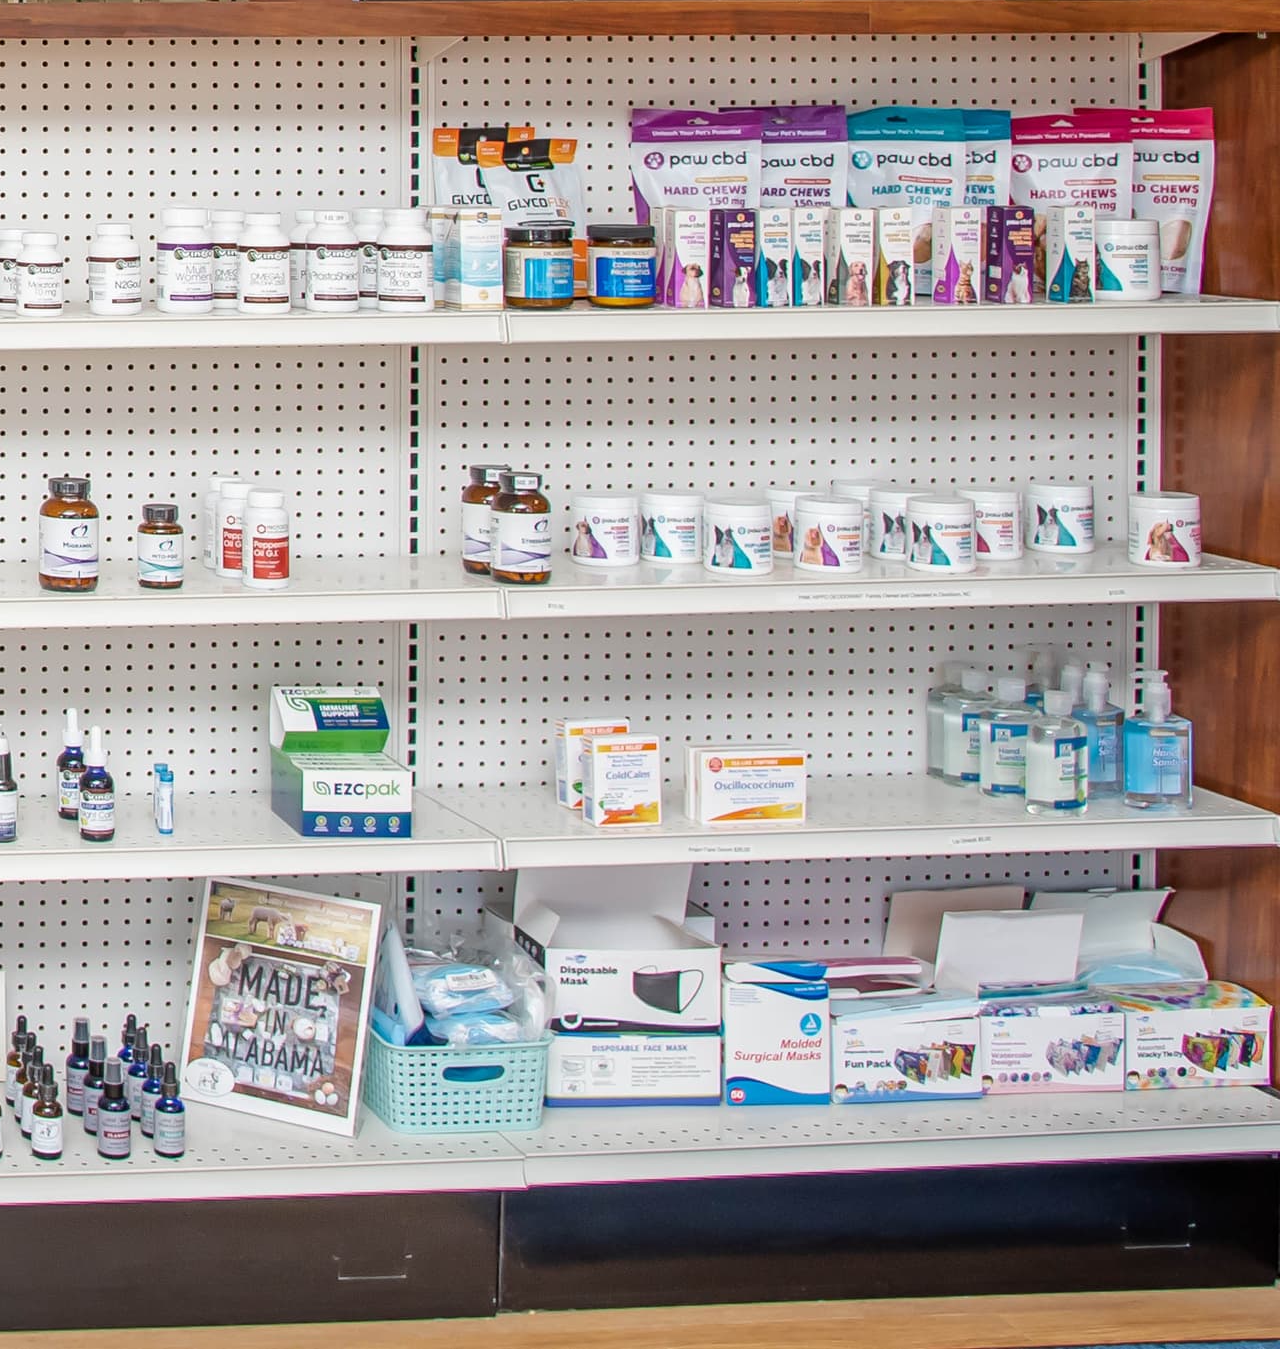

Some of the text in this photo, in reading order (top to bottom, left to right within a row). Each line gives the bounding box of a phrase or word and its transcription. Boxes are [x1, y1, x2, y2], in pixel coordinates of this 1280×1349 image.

[696, 129, 711, 137] Pet's
[670, 152, 747, 168] paw cbd
[800, 154, 834, 167] cbd
[877, 153, 952, 168] paw cbd
[1038, 153, 1119, 171] paw cbd
[1163, 151, 1200, 164] cbd
[664, 185, 747, 196] HARD CHEWS
[790, 188, 831, 197] CHEWS
[872, 185, 952, 196] HARD CHEWS
[1030, 189, 1117, 200] HARD CHEWS
[1150, 185, 1199, 194] CHEWS
[708, 197, 746, 208] 150 mg
[908, 196, 930, 205] 300
[1153, 195, 1197, 207] 600 mg
[1100, 202, 1116, 212] mg
[399, 269, 422, 279] Yeast
[388, 278, 410, 287] Rice
[254, 549, 266, 557] Oil
[605, 769, 651, 780] ColdCalm
[334, 781, 400, 799] EZCpak
[714, 780, 795, 791] Oscillococcinum
[559, 965, 618, 977] Disposable
[559, 976, 589, 986] Mask
[238, 963, 327, 1011] MADE
[265, 1008, 287, 1035] IN
[592, 1044, 688, 1052] DISPOSABLE FACE MASK
[780, 1038, 822, 1049] Molded
[734, 1051, 822, 1063] Surgical Masks
[844, 1060, 892, 1069] Fun Pack
